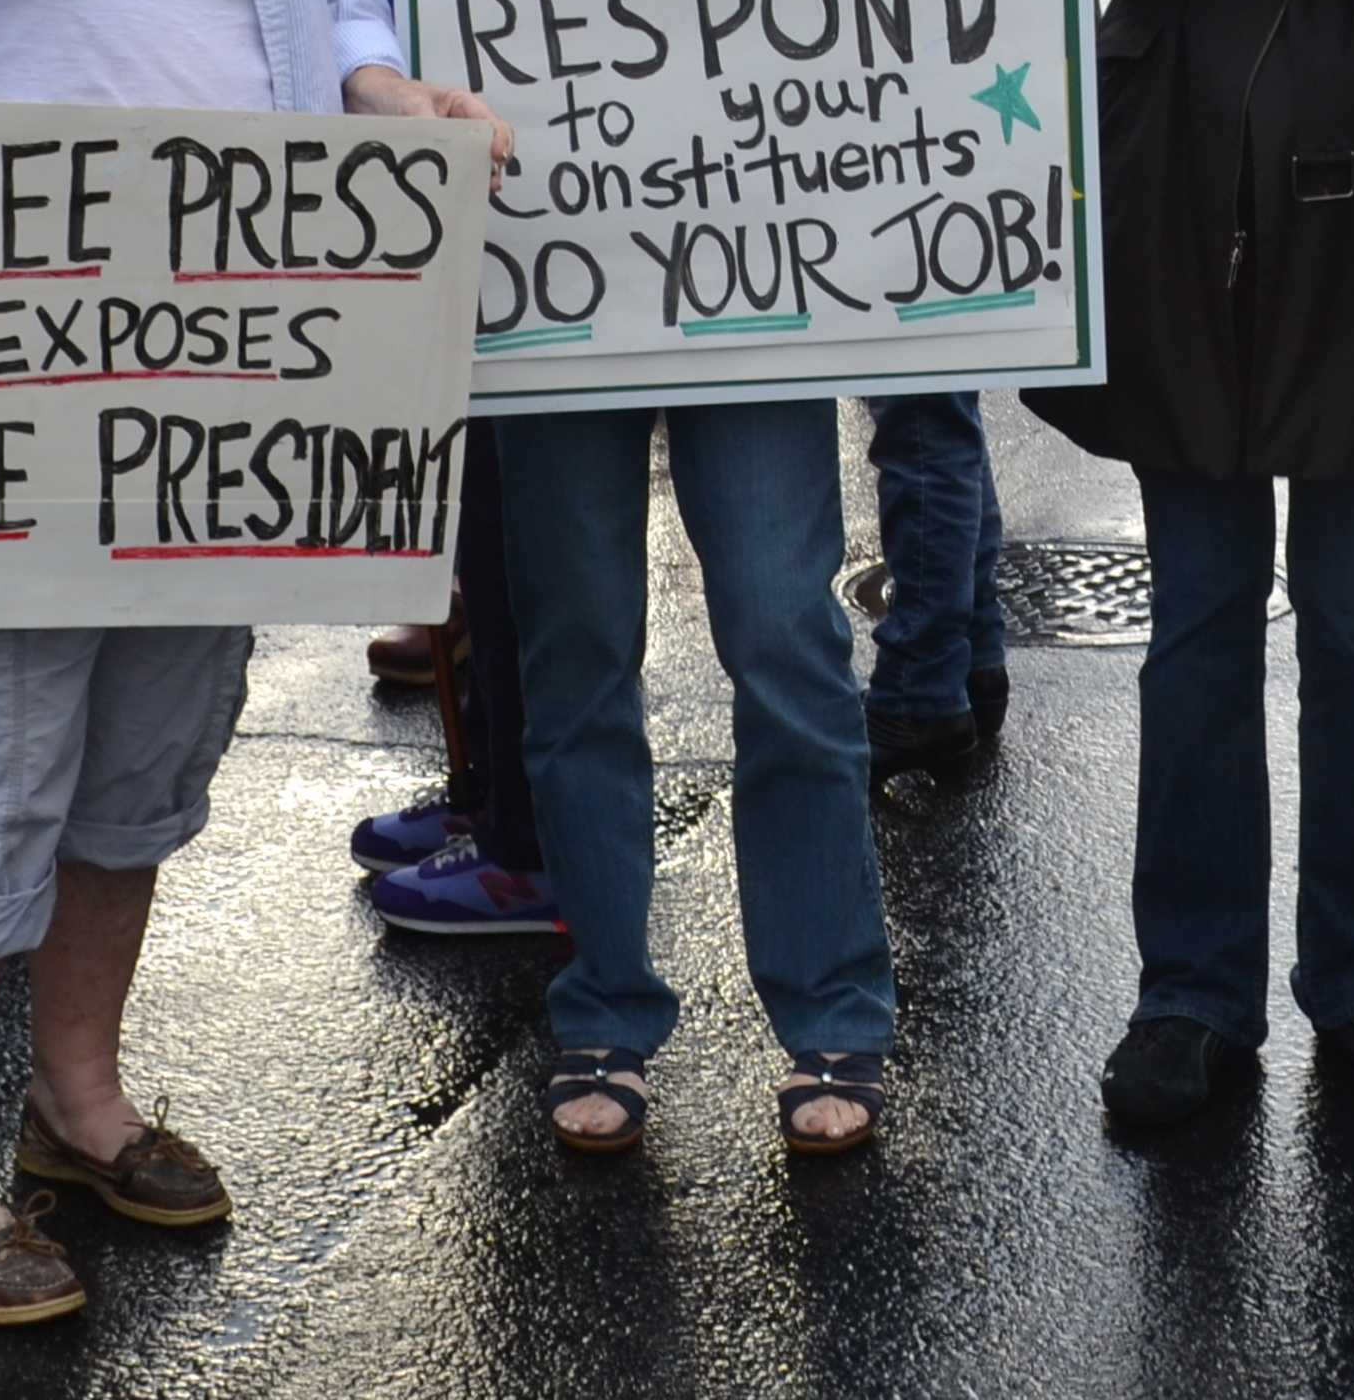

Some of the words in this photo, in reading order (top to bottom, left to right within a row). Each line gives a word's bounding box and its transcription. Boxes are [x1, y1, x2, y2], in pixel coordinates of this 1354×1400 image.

[548, 81, 636, 153] to
[719, 70, 910, 150] your
[151, 135, 449, 275] PRESS
[475, 239, 607, 335] DO
[631, 217, 871, 328] YOUR
[871, 165, 1064, 302] JOB!
[97, 406, 467, 556] PRESIDENT
